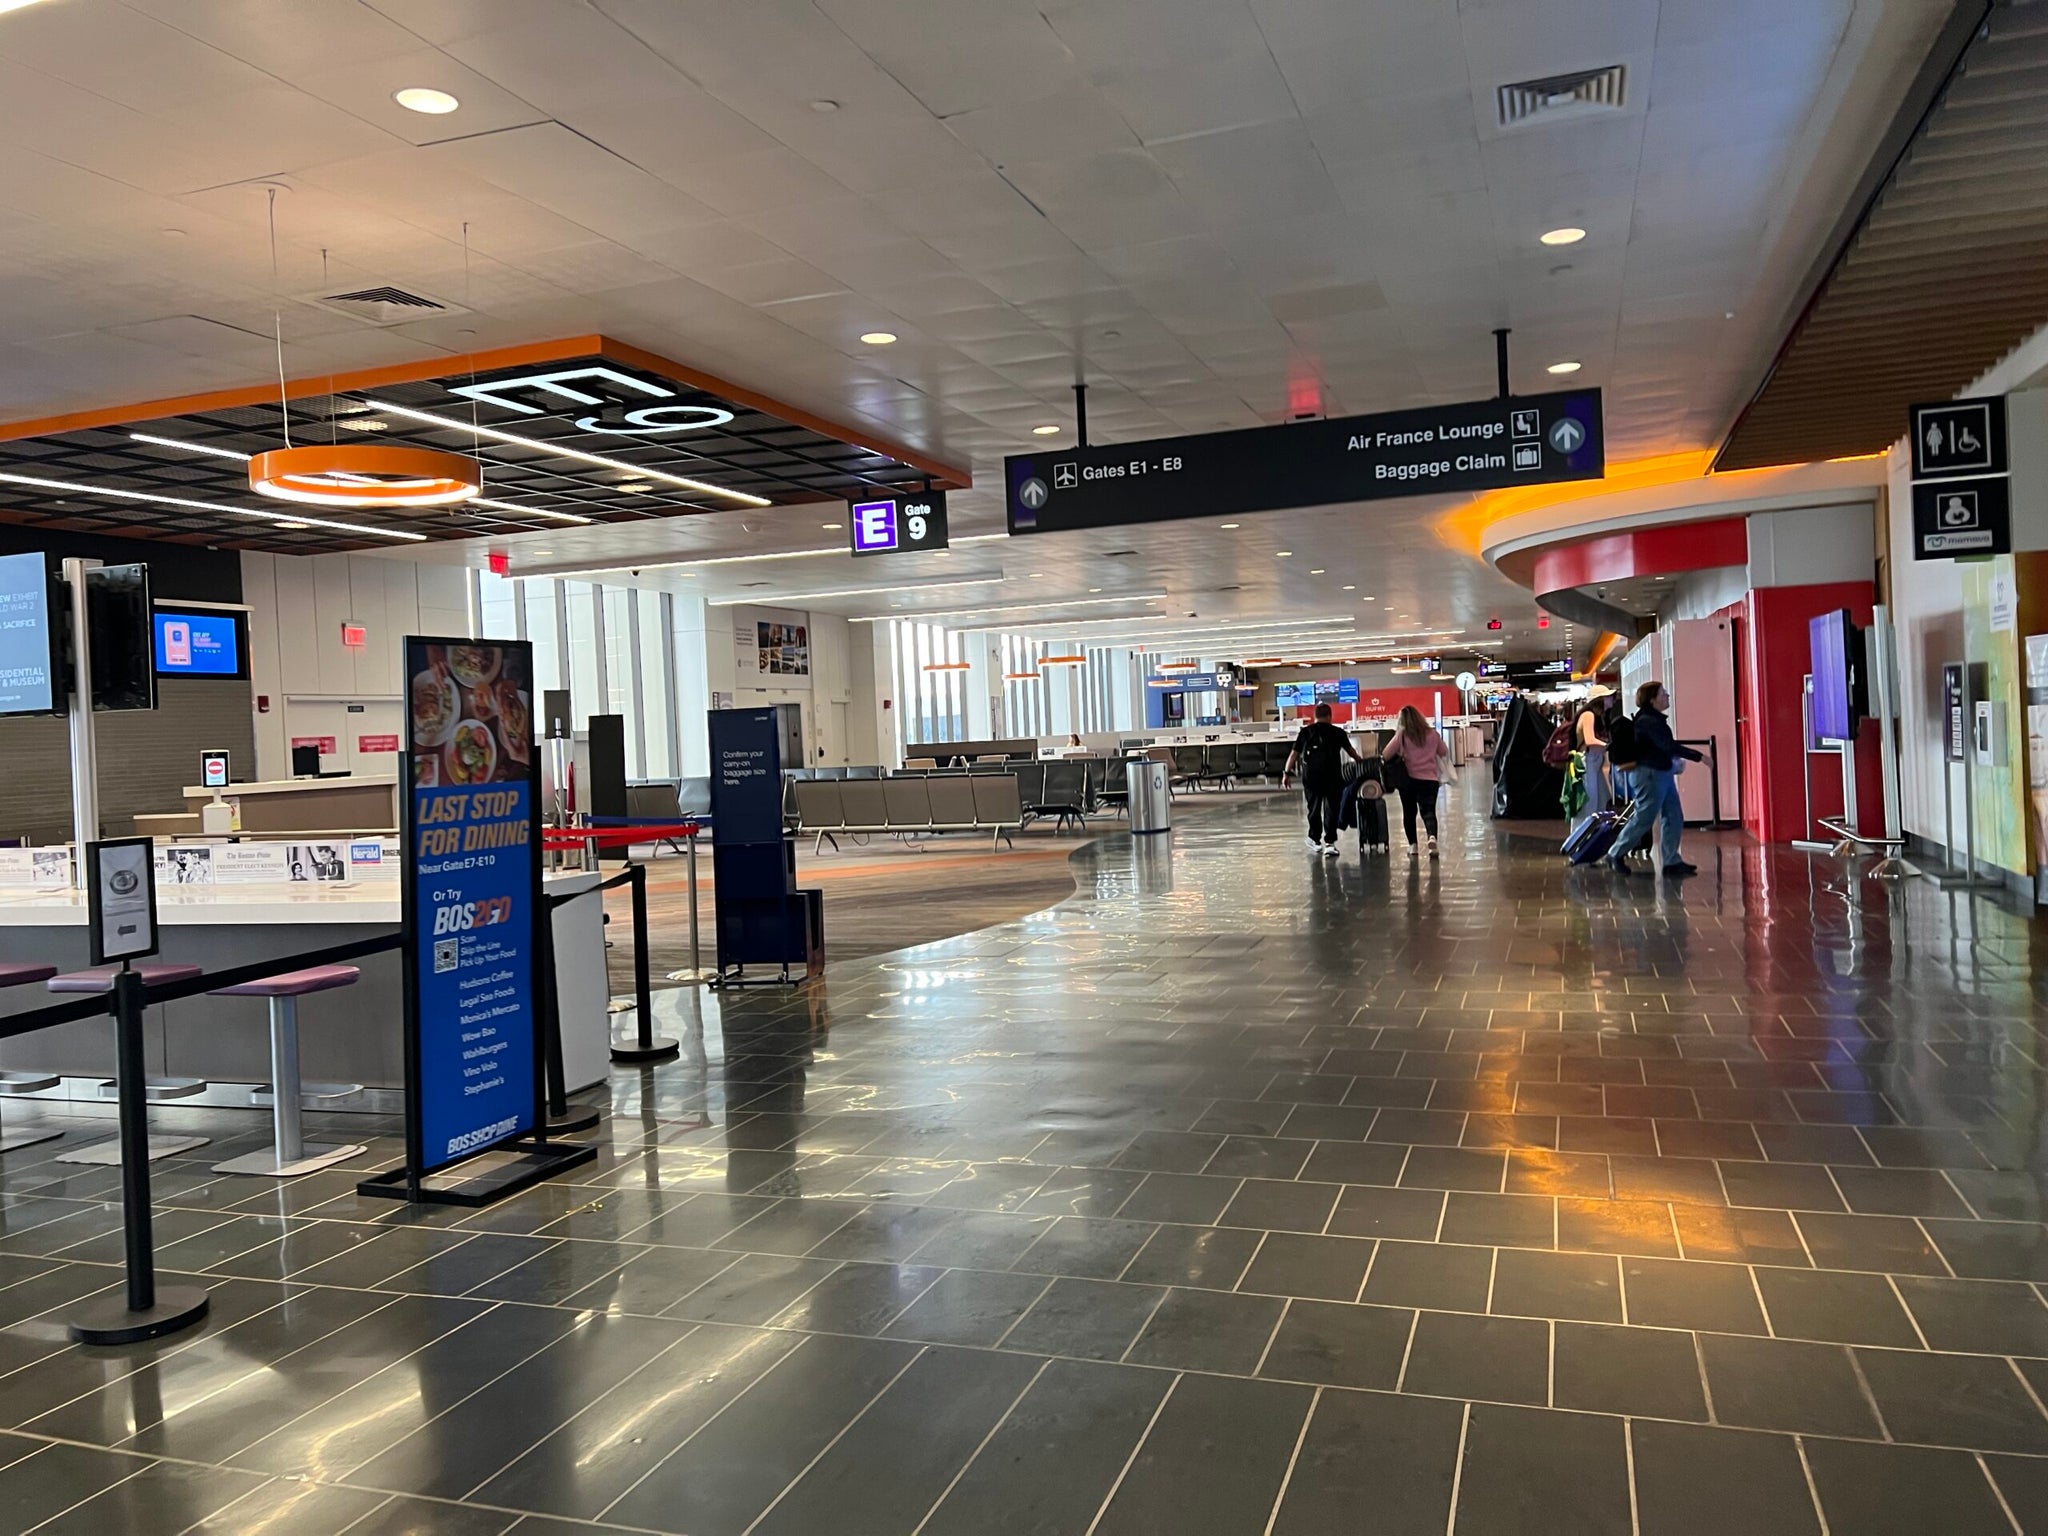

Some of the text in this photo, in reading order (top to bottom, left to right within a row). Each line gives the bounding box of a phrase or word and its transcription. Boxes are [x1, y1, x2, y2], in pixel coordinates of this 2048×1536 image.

[1348, 422, 1504, 450] Air France Lounge
[1083, 465, 1125, 480] Gates
[1130, 461, 1147, 475] E1
[1163, 457, 1182, 471] E8
[1375, 453, 1506, 480] Baggage Claim
[904, 504, 931, 516] Gate
[862, 508, 889, 544] E
[908, 516, 927, 540] 9
[10, 602, 28, 611] WAR
[29, 602, 34, 610] 2
[10, 676, 45, 687] MUSEUM
[723, 750, 764, 759] Confirm your
[723, 760, 751, 768] carry-on
[723, 769, 752, 777] baggage
[418, 790, 519, 825] LAST STOP
[419, 820, 529, 858] FOR DINING
[352, 847, 379, 860] Herald
[419, 855, 496, 875] Near Gate E7-E10
[433, 888, 462, 902] Or Try
[433, 896, 511, 935] BOS2GO
[460, 935, 477, 945] Scan
[460, 942, 501, 957] Skip the Line
[460, 948, 517, 968] Pick Up Your Food
[460, 970, 514, 989] Hudsons Coffee
[460, 986, 516, 1008] Legal Sea Foods
[460, 1003, 520, 1025] Monica's Mercato
[461, 1027, 497, 1043] Wow Bao
[462, 1041, 508, 1060] Wahlburgers
[463, 1061, 498, 1077] Vino Volo
[463, 1076, 505, 1096] Stephanie's
